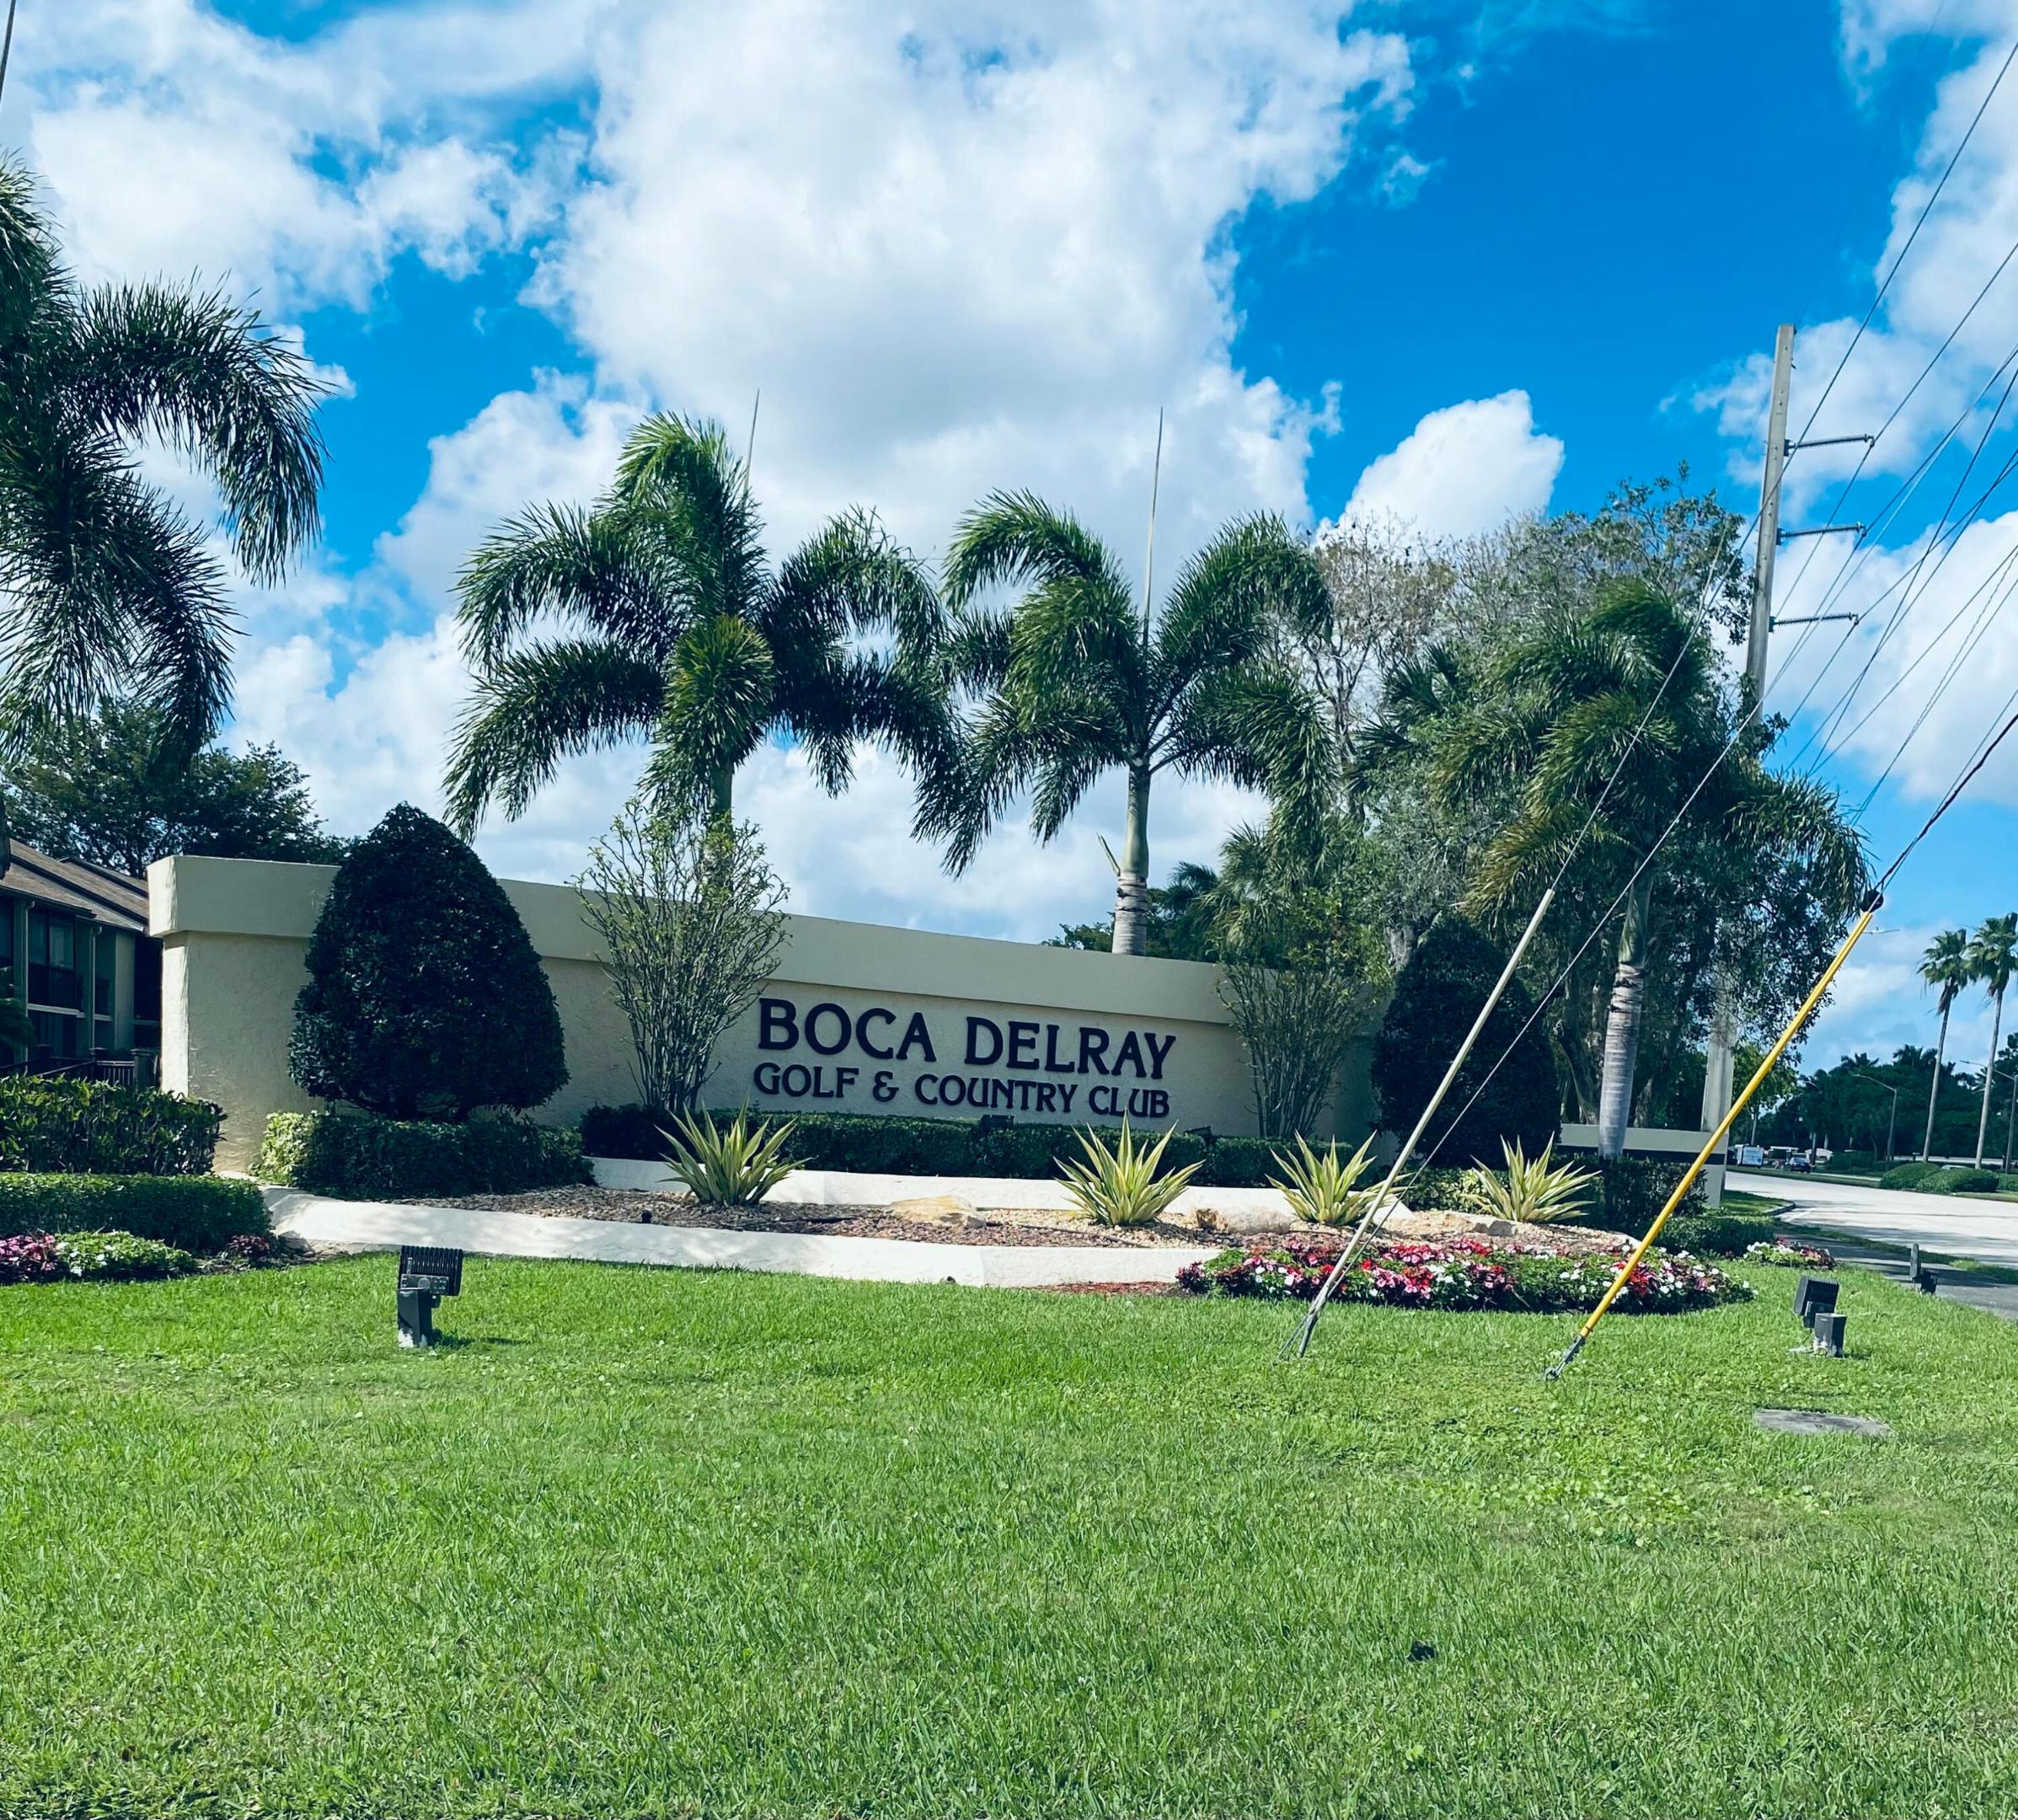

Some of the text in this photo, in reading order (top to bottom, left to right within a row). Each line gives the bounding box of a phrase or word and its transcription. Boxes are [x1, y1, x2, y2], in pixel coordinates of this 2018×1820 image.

[757, 998, 1176, 1079] BOCA DELRAY
[753, 1062, 1170, 1118] GOLF & COUNTRY CLUB
